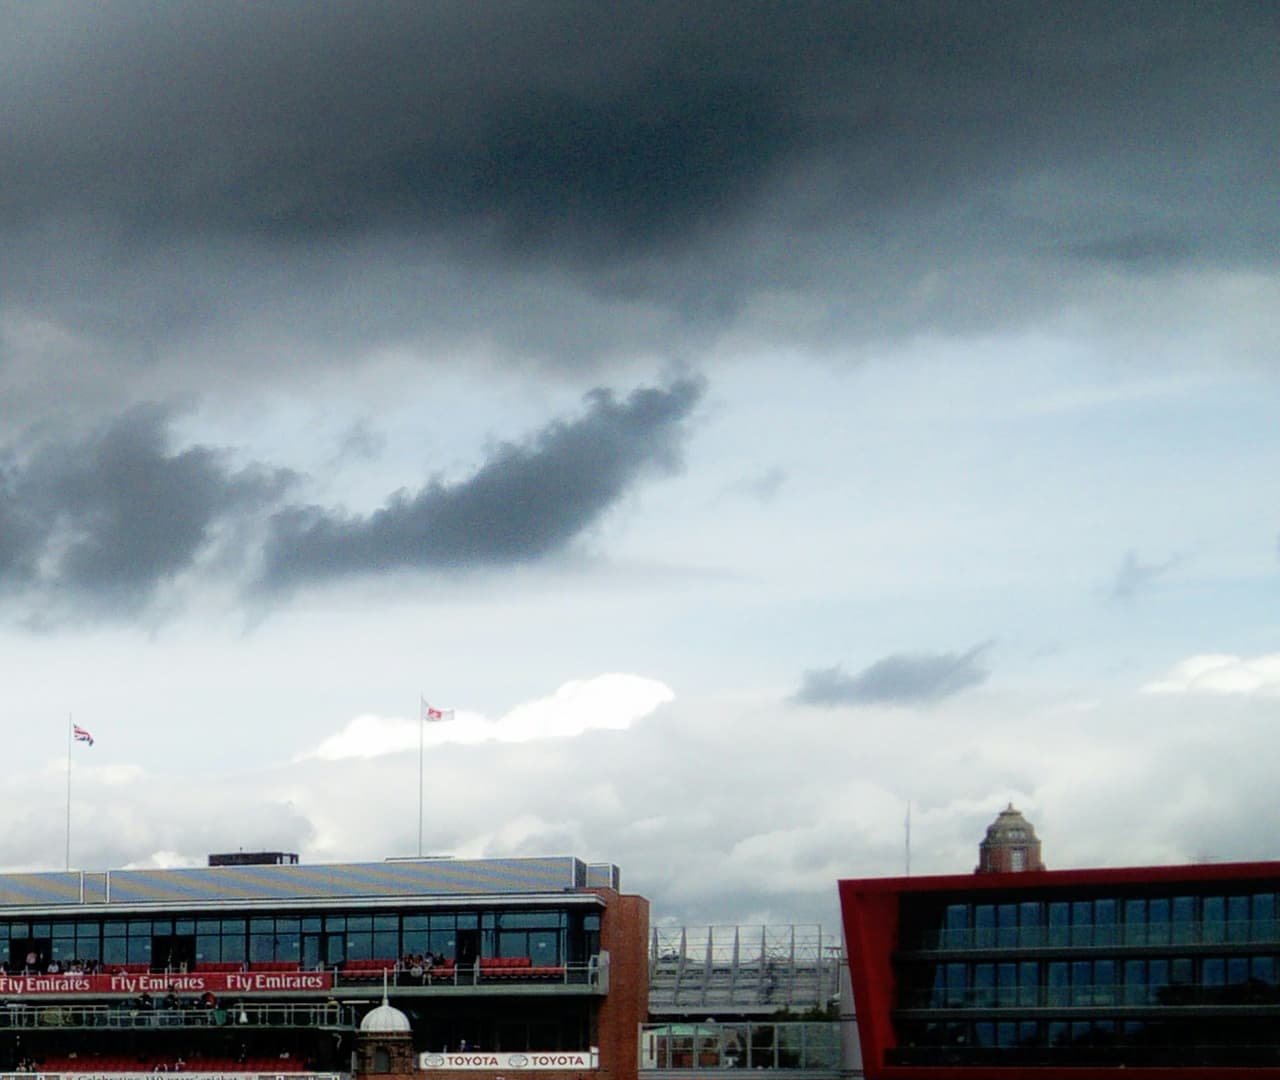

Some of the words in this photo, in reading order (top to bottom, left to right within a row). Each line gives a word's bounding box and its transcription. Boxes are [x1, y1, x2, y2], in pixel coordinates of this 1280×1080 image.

[0, 978, 24, 993] Fly
[26, 978, 89, 991] Emirates
[111, 976, 136, 992] Fly
[140, 976, 204, 990] Emirates
[226, 974, 252, 990] Fly
[255, 974, 322, 988] Emirates
[448, 1056, 498, 1066] TOYOTA
[531, 1056, 584, 1065] TOYOTA
